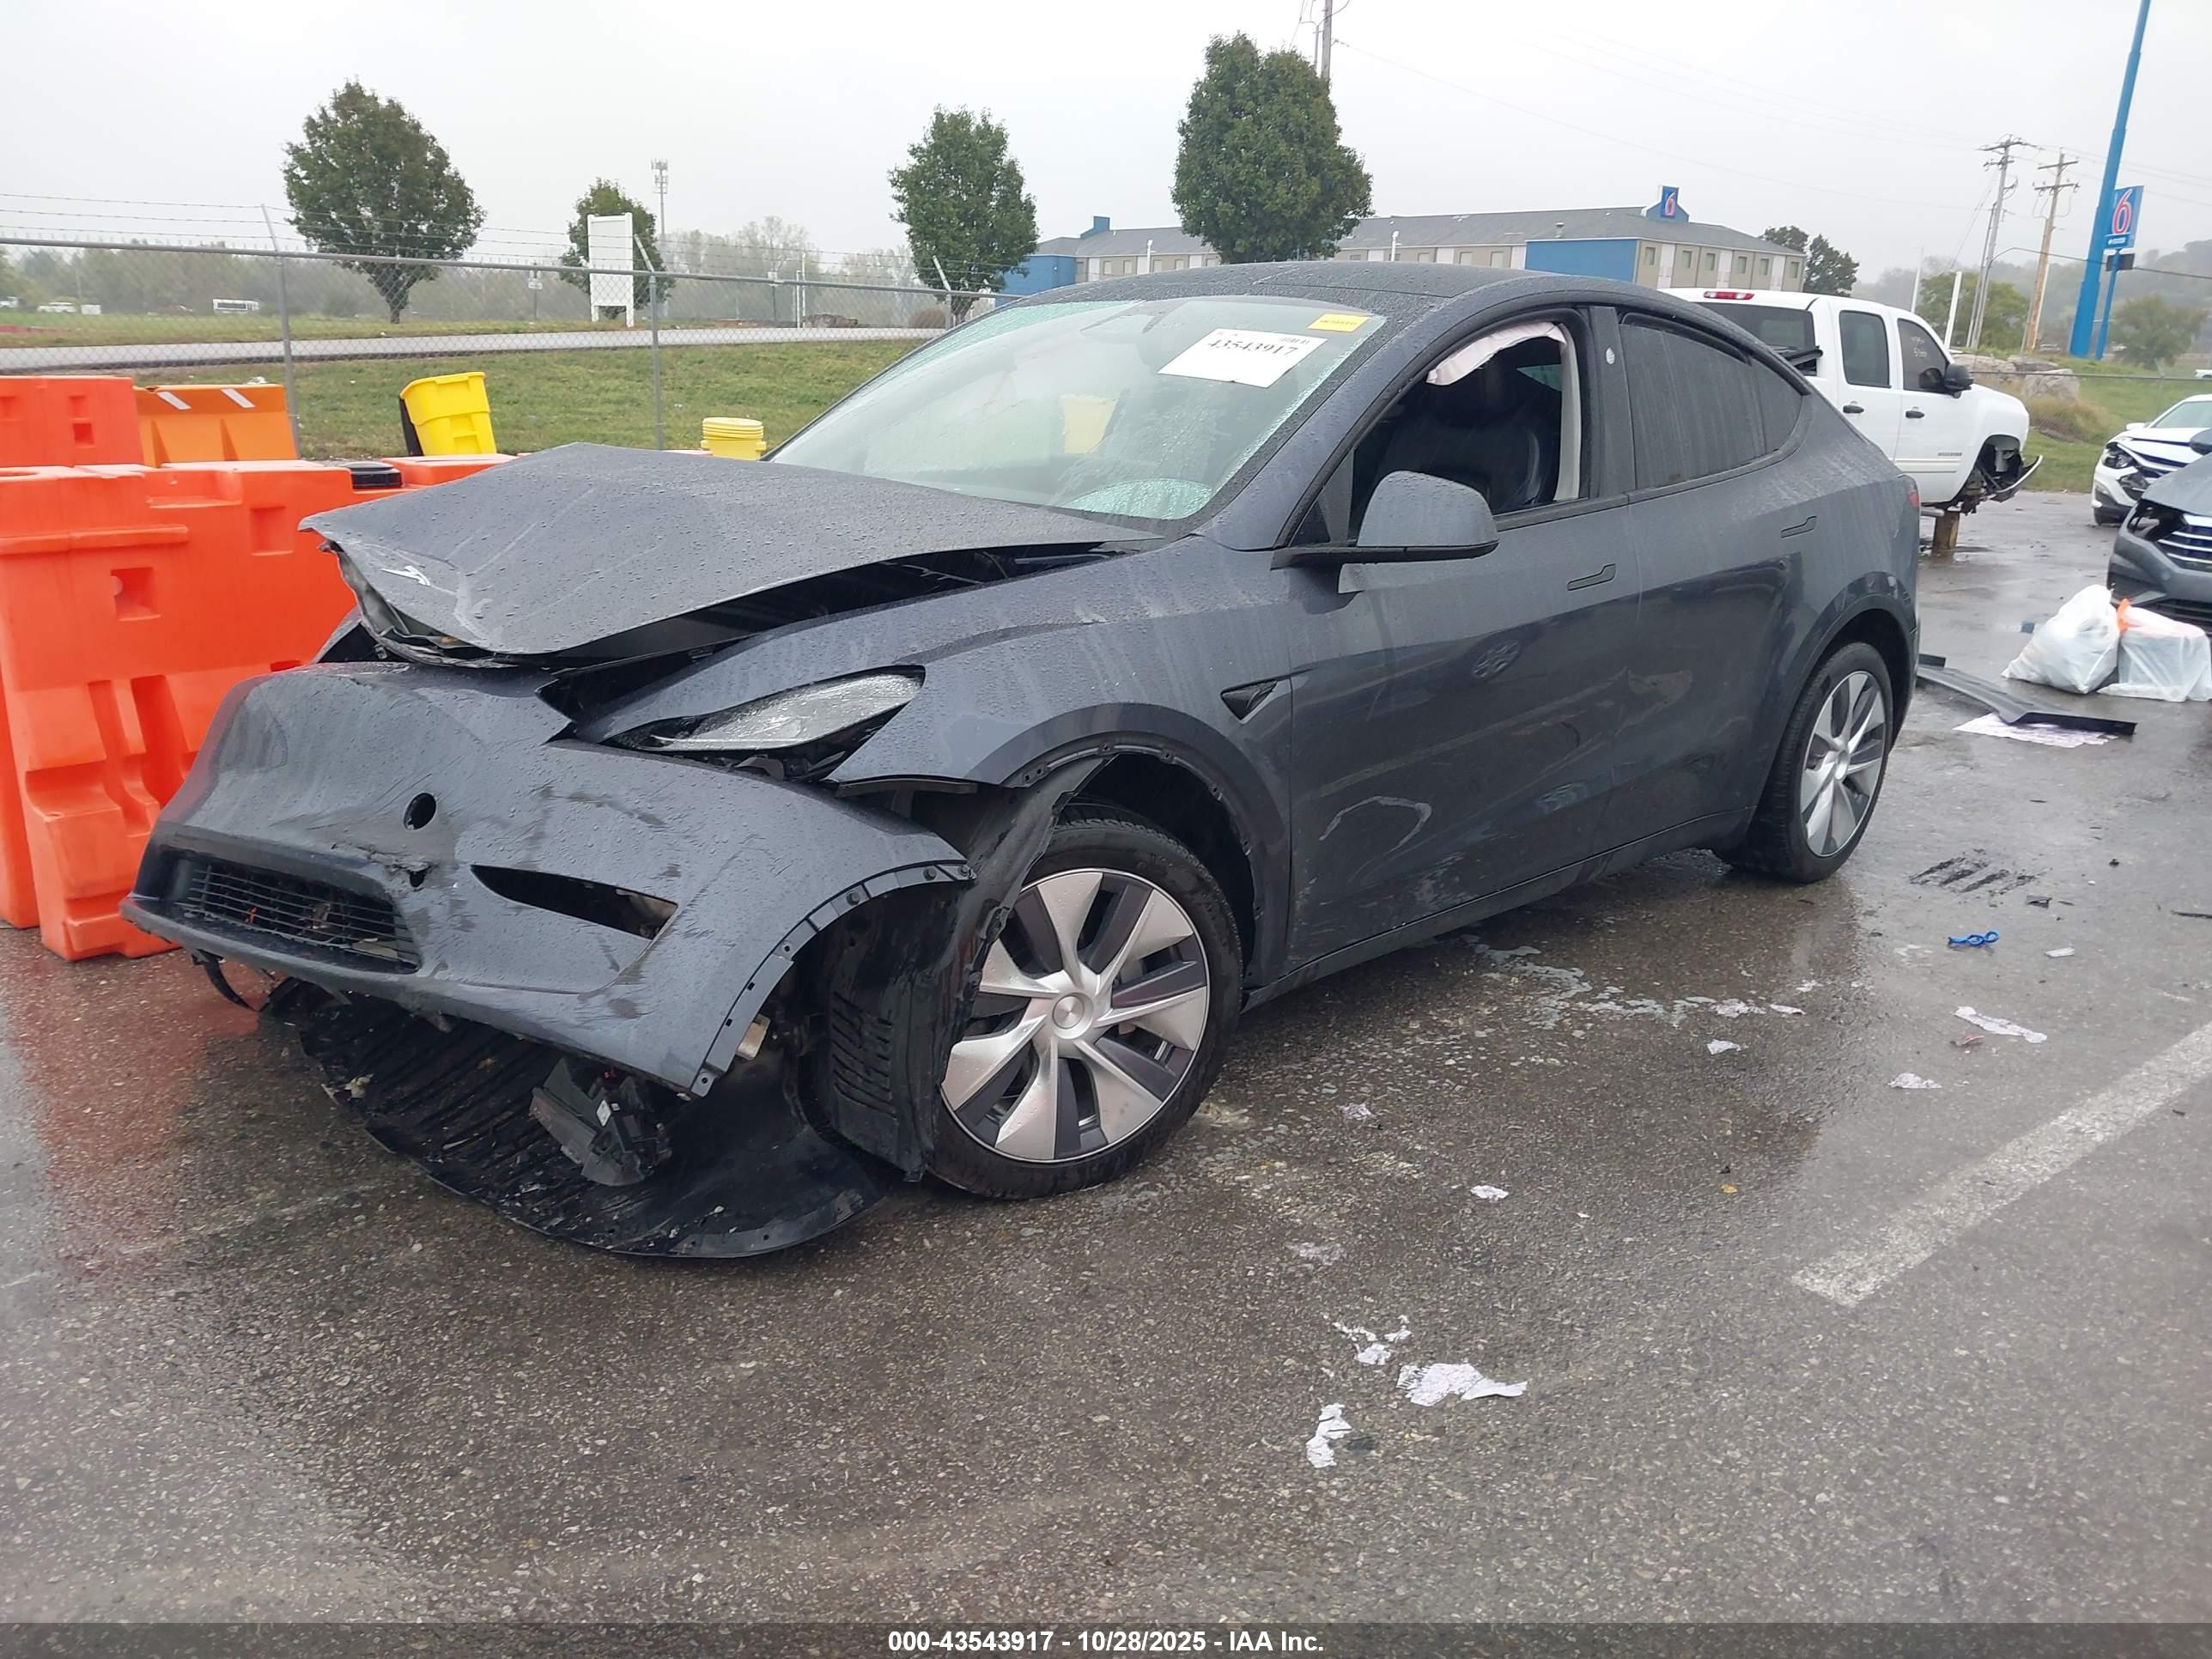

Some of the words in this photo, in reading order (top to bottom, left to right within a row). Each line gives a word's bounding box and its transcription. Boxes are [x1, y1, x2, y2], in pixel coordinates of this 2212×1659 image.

[1665, 191, 1676, 216] 6
[2112, 188, 2132, 234] 6
[1207, 339, 1299, 356] 43543917
